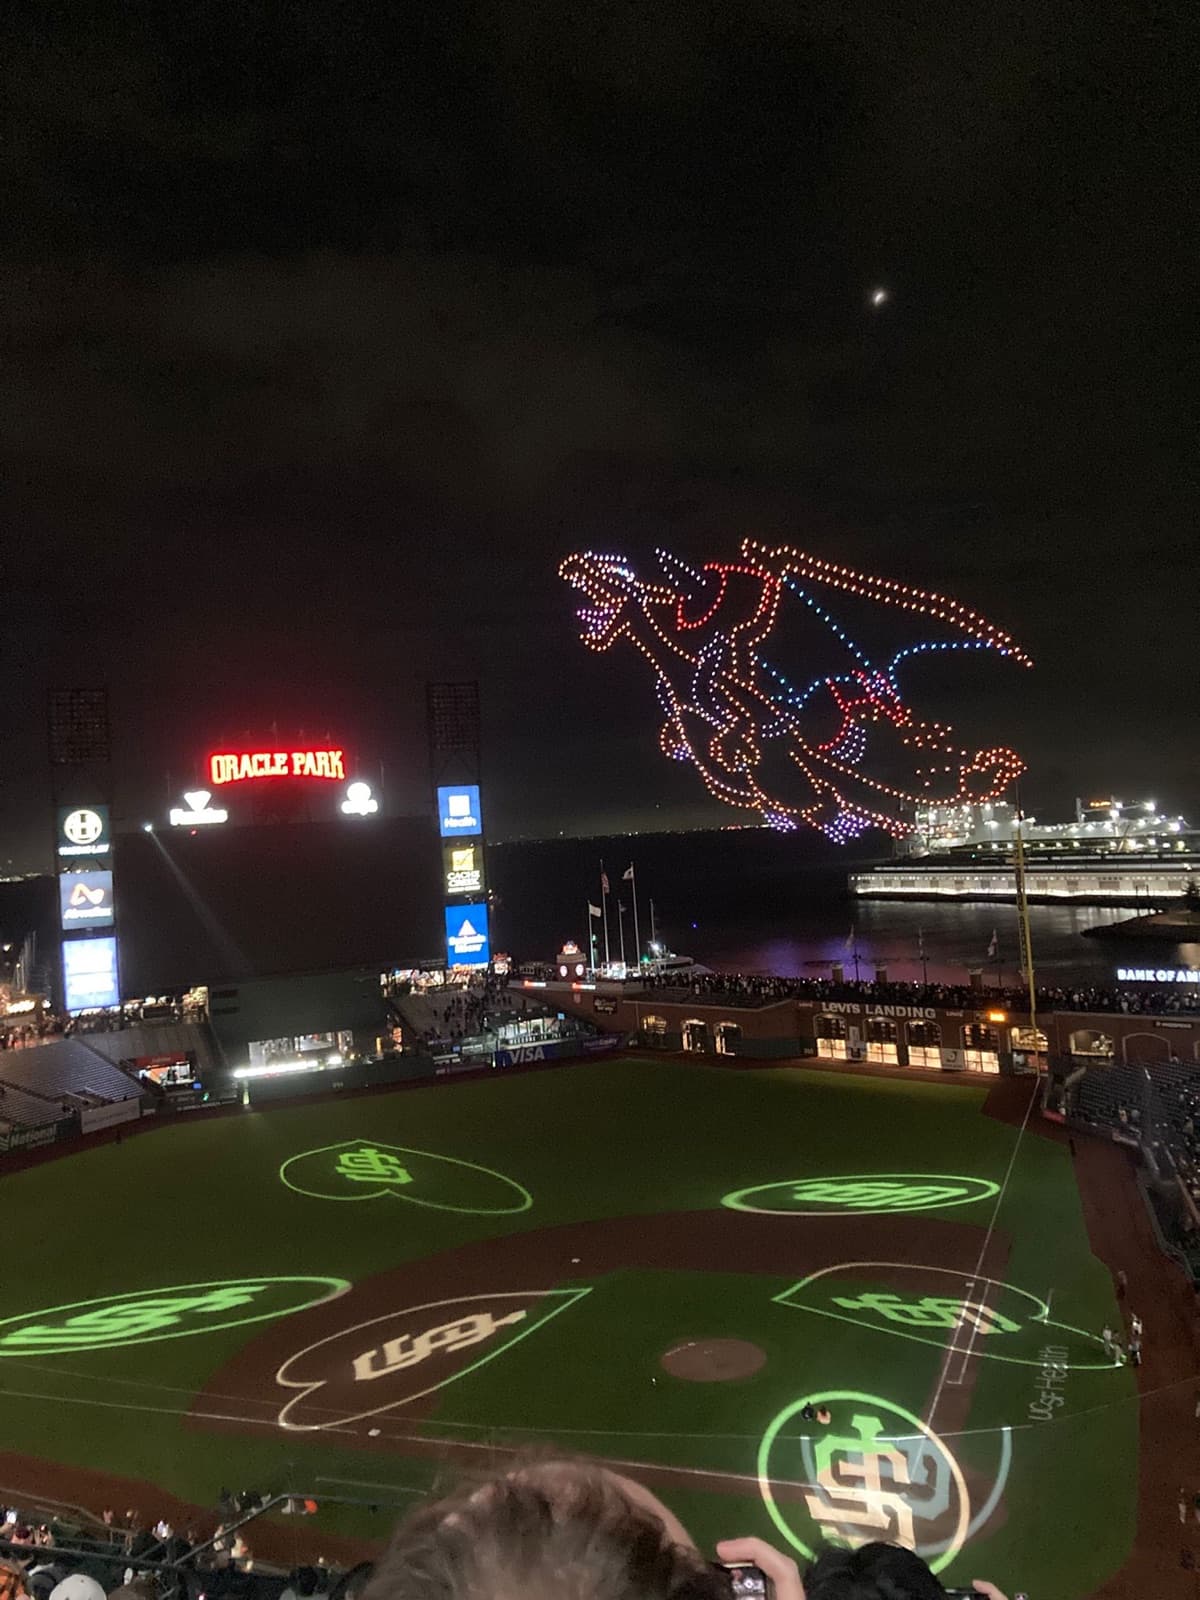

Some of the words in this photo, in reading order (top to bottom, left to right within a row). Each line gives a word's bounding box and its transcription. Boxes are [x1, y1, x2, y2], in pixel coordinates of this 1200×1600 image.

[211, 753, 289, 785] ORACLE
[292, 751, 345, 779] PARK
[1117, 968, 1156, 981] BANK
[1156, 969, 1175, 982] OF
[864, 1004, 937, 1019] LANDING
[509, 1047, 545, 1064] VISA
